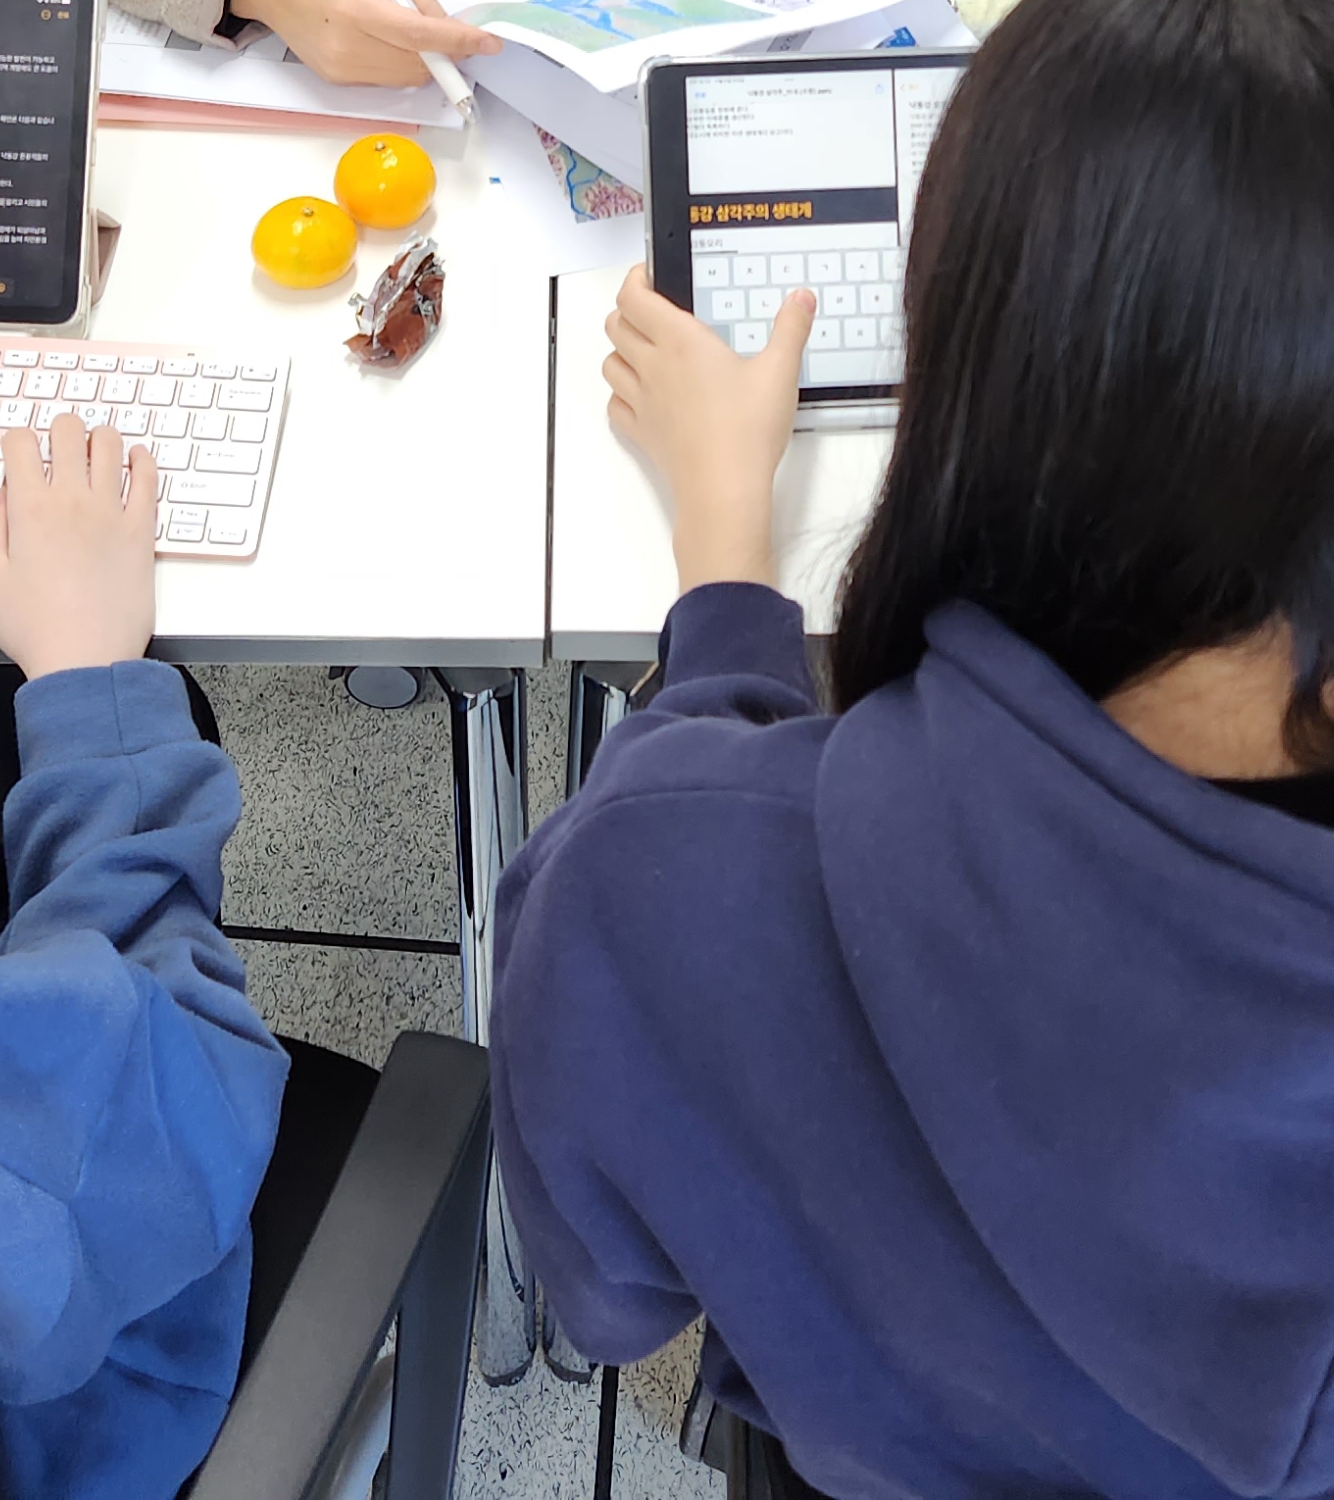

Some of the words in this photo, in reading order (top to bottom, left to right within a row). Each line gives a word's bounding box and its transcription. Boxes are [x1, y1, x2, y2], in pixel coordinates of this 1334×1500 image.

[716, 202, 769, 222] 삼각주의
[772, 201, 812, 221] 생태계
[8, 404, 17, 413] U
[85, 408, 96, 418] O
